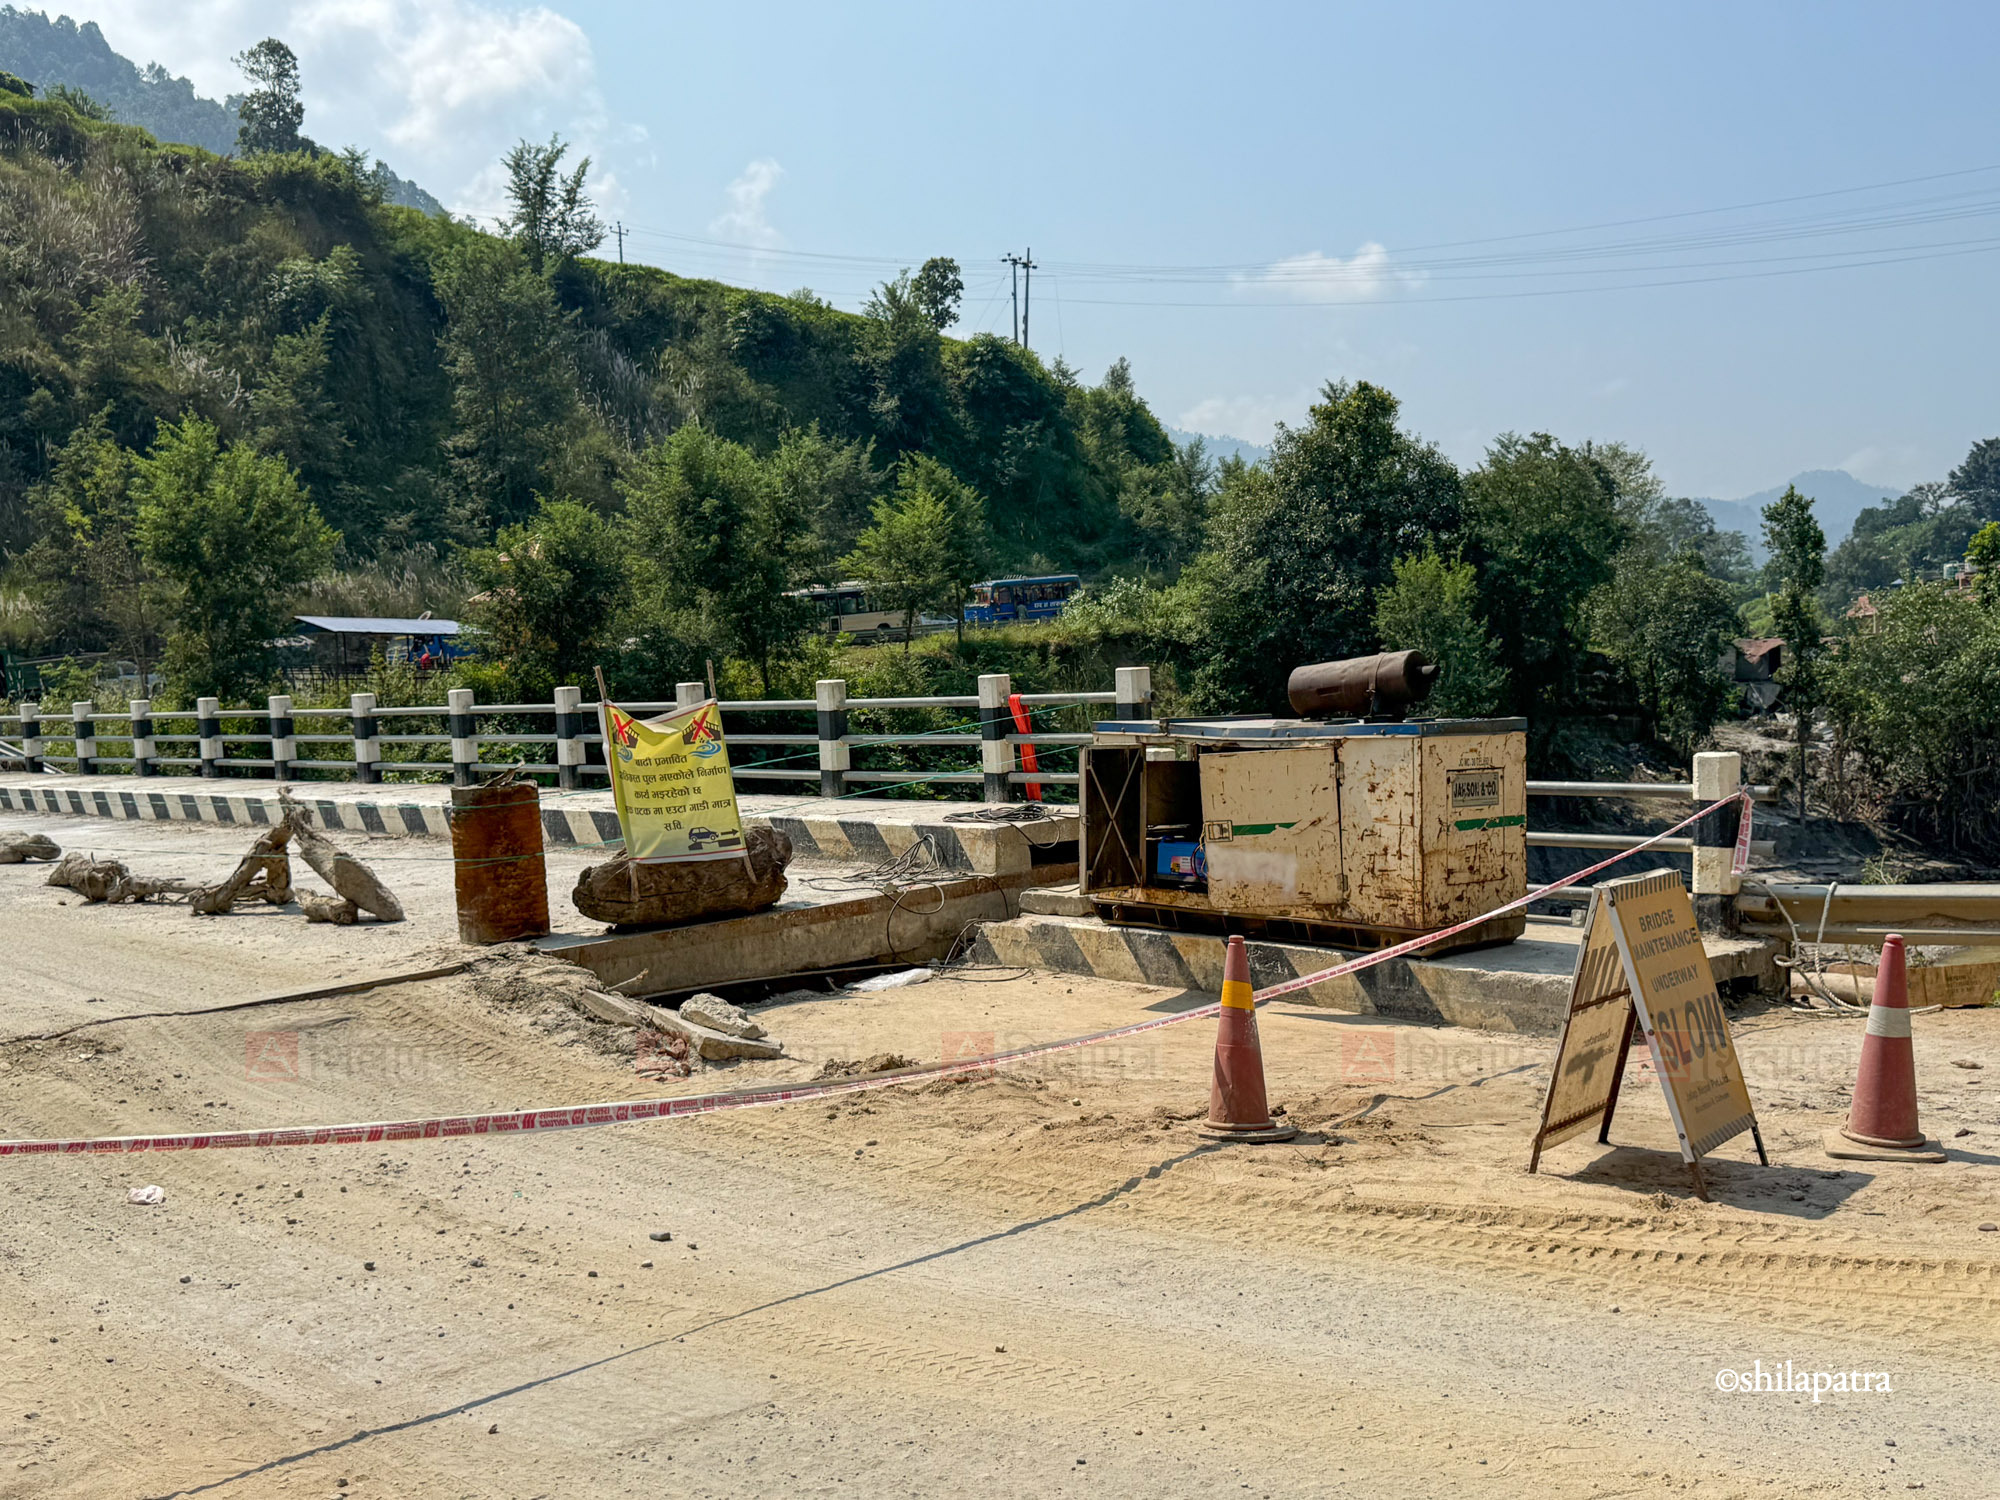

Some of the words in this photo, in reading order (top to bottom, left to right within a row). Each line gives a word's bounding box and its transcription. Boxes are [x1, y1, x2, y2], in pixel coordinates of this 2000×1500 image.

[697, 765, 727, 777] निर्माण
[1639, 908, 1676, 932] BRIDGE
[1632, 927, 1699, 960] MAINTENANCE
[1651, 963, 1698, 993] UNDERWAY
[1657, 991, 1727, 1070] SLOW
[386, 1129, 421, 1140] CAUTION
[442, 1126, 472, 1136] DANGER
[92, 1140, 122, 1150] खतरा
[152, 1138, 175, 1148] MEN
[177, 1137, 190, 1147] AT
[336, 1135, 363, 1144] WORK
[18, 1142, 59, 1153] सावधान
